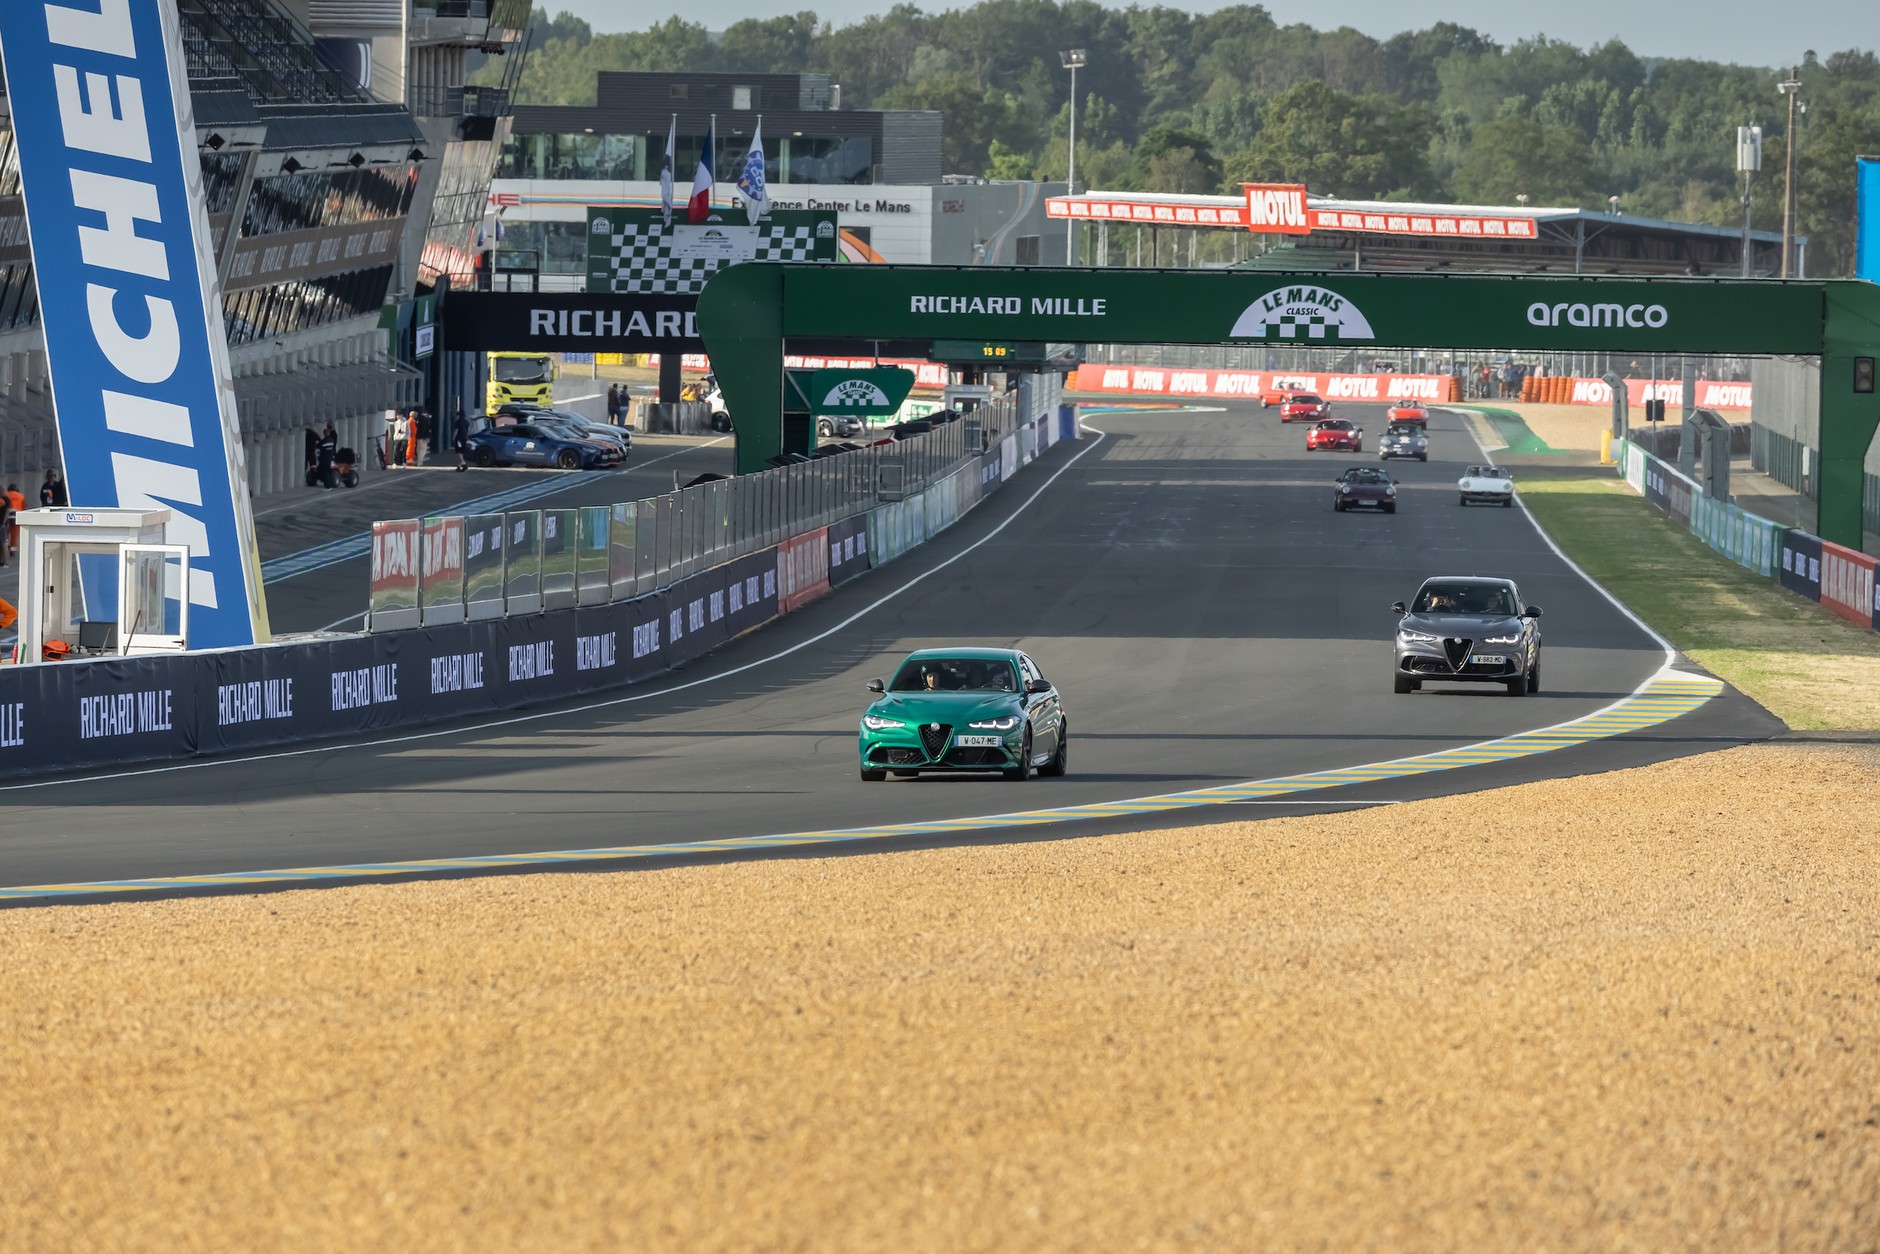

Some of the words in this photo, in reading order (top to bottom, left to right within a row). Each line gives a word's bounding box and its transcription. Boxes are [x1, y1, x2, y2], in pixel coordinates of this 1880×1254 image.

[807, 199, 850, 212] Center
[855, 199, 871, 212] Le
[875, 199, 911, 213] Mans
[1249, 190, 1306, 226] MOTUL
[910, 295, 1021, 315] RICHARD
[1031, 297, 1107, 316] MILLE
[1262, 292, 1283, 313] LE
[1286, 288, 1344, 312] MANS
[1286, 307, 1319, 316] CLASSIC
[1527, 302, 1668, 328] aramco
[849, 381, 877, 394] MANS
[1169, 372, 1208, 393] MOTUL
[1214, 374, 1260, 394] MOTUL
[1326, 377, 1379, 398] MOTUL
[1387, 378, 1440, 398] MOTUL
[431, 655, 461, 694] RICHARD
[463, 651, 483, 690] MILLE
[332, 668, 370, 711] RICHARD
[372, 663, 397, 704] MILLE
[81, 693, 134, 739] RICHARD
[138, 689, 172, 733] MILLE
[218, 681, 261, 726] RICHARD
[264, 678, 293, 719] MILLE
